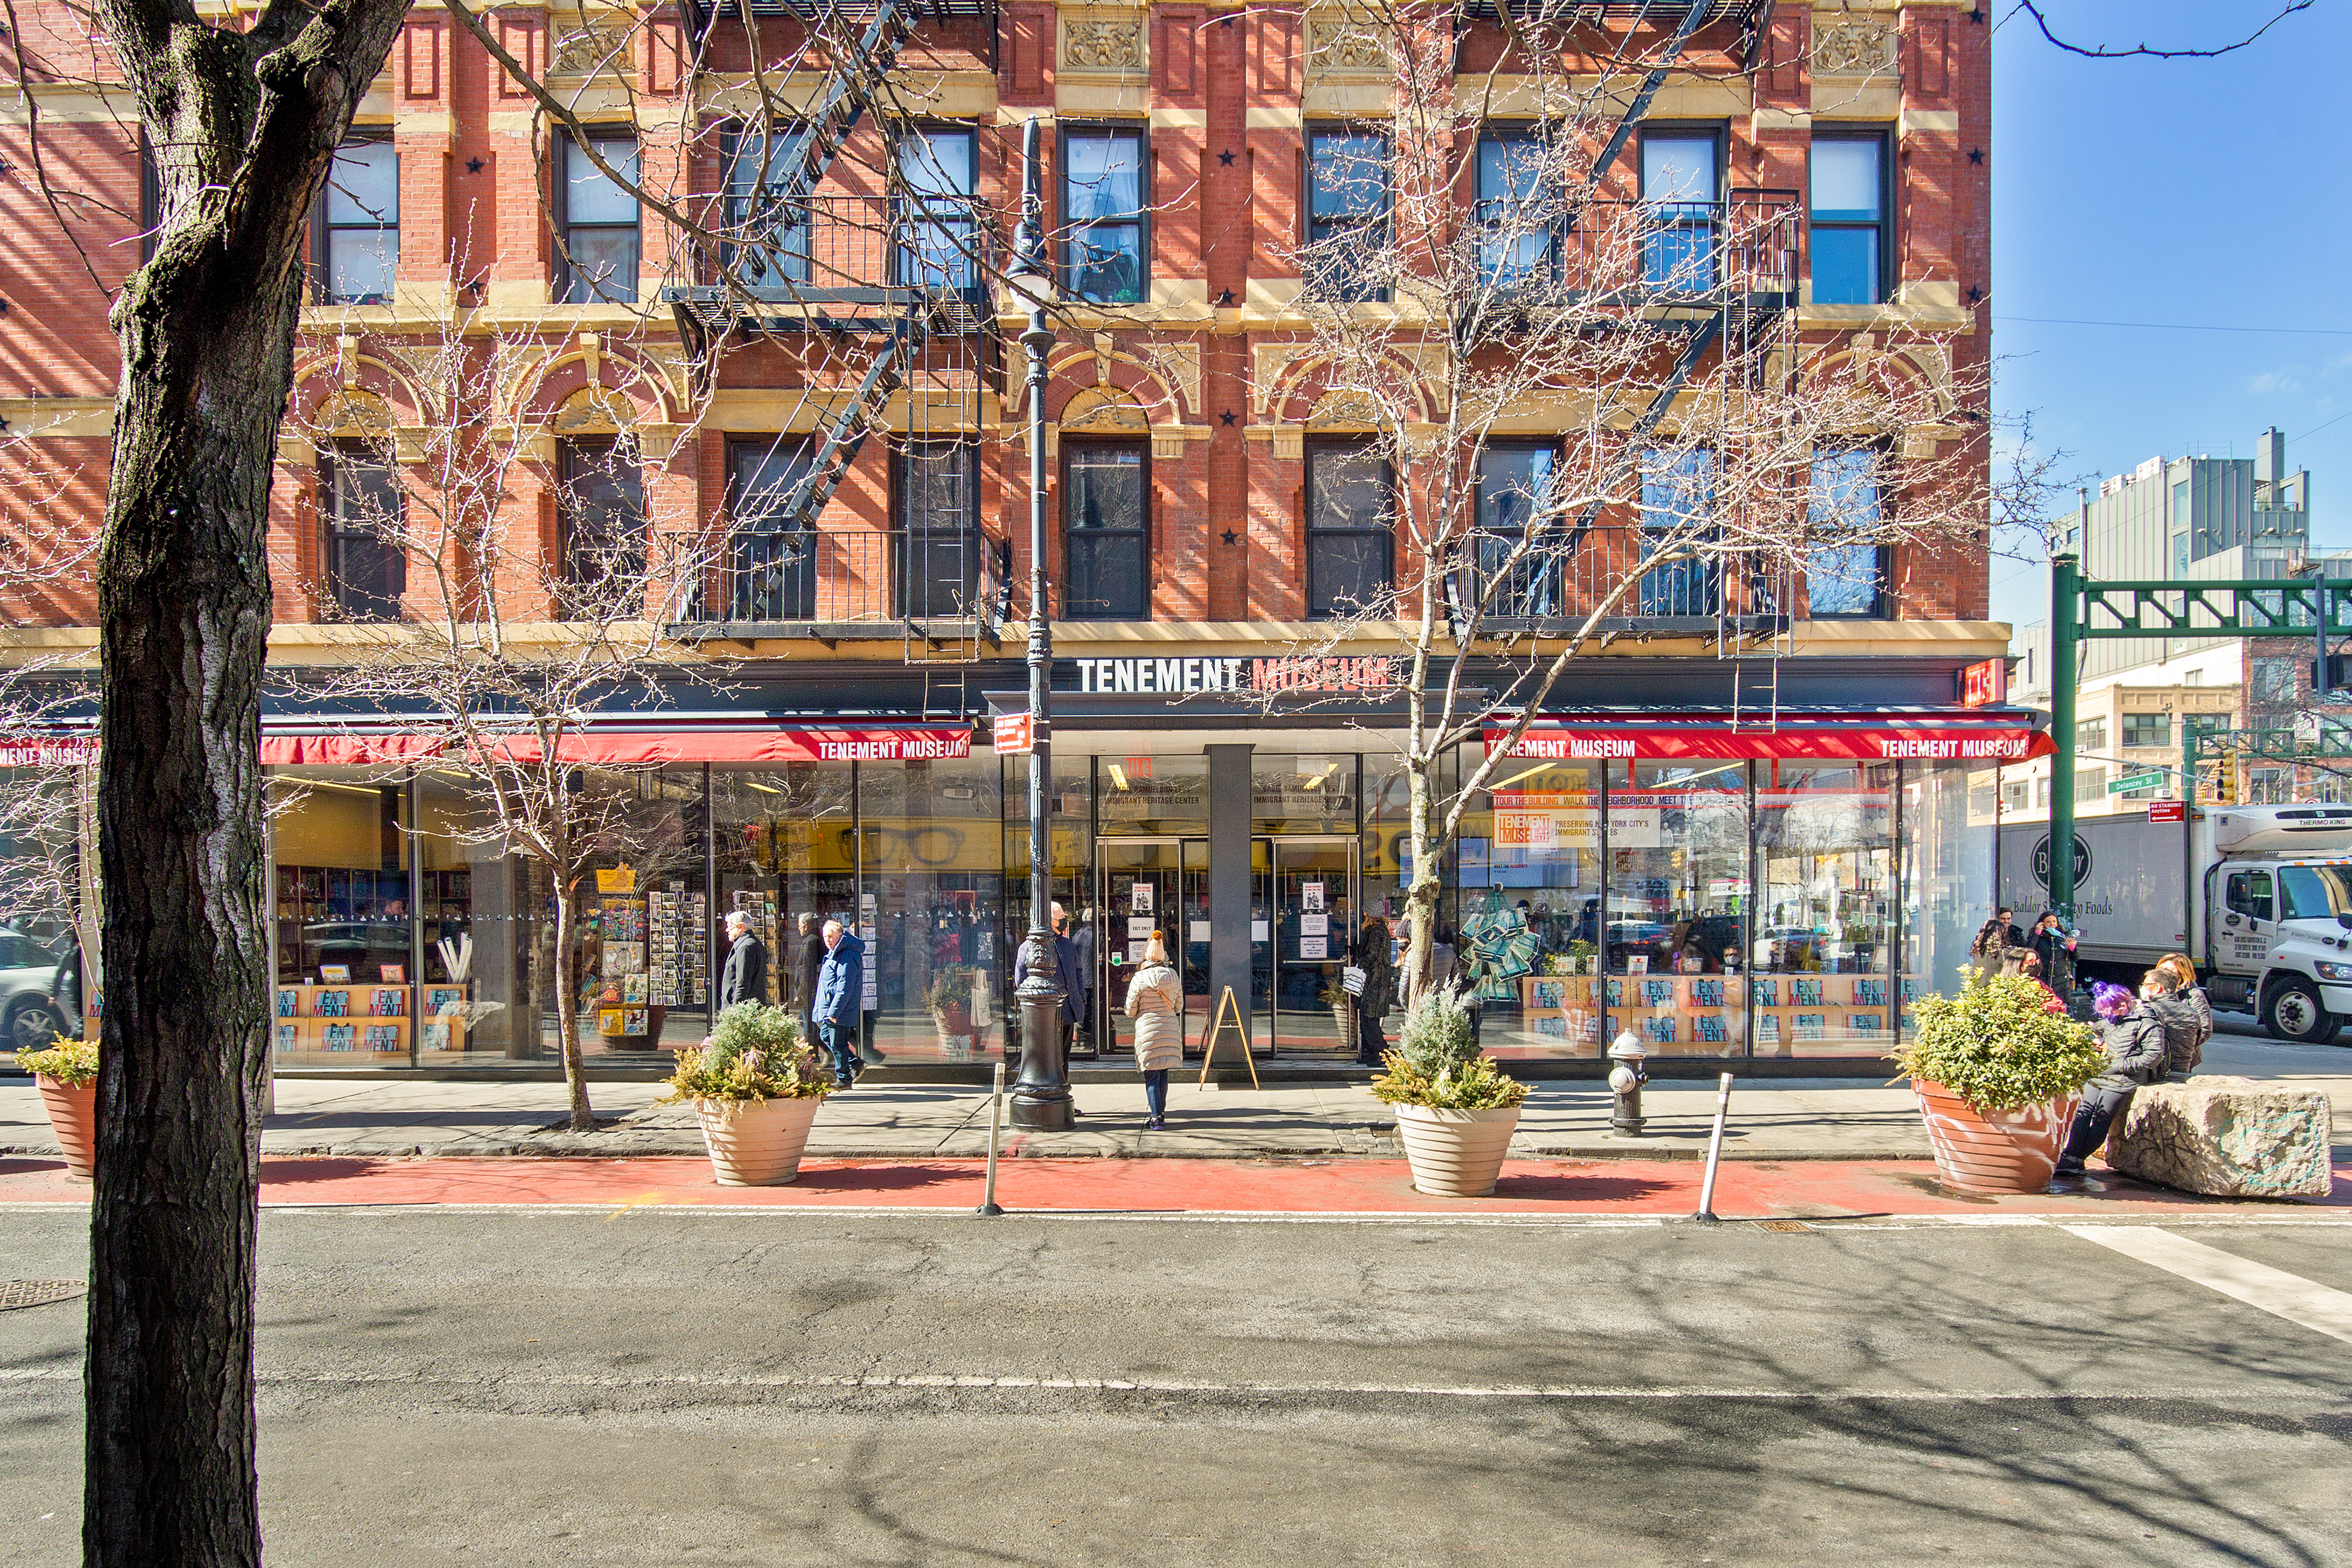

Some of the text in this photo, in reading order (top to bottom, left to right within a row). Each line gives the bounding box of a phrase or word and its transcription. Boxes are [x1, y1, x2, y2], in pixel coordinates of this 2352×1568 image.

[1076, 658, 1388, 692] TENEMENT MUSEUM
[819, 740, 967, 759] TENEMENT MUSEUM
[1488, 740, 1635, 757] TEMENT MUSEUM
[1880, 740, 2026, 757] TENEMENT MUSEUM
[2116, 780, 2142, 790] Delancey
[1495, 797, 1513, 805] TOUR
[1515, 797, 1526, 805] THE
[1529, 797, 1558, 805] BUILDING
[1563, 797, 1583, 805] WALK
[1587, 797, 1599, 805] THE
[1658, 796, 1677, 804] MEET
[1499, 815, 1549, 828] TENEMENT
[2013, 896, 2041, 913] Baldor
[2085, 896, 2112, 915] Foods
[1691, 995, 1724, 1006] MENT
[1790, 994, 1823, 1006] MENT
[1854, 993, 1887, 1005] MENT
[313, 1005, 348, 1017] MENT
[369, 1004, 402, 1016] MENT
[1643, 1030, 1676, 1042] MENT
[1694, 1029, 1726, 1041] MENT
[321, 1039, 354, 1051] MENT
[364, 1039, 398, 1051] MENT
